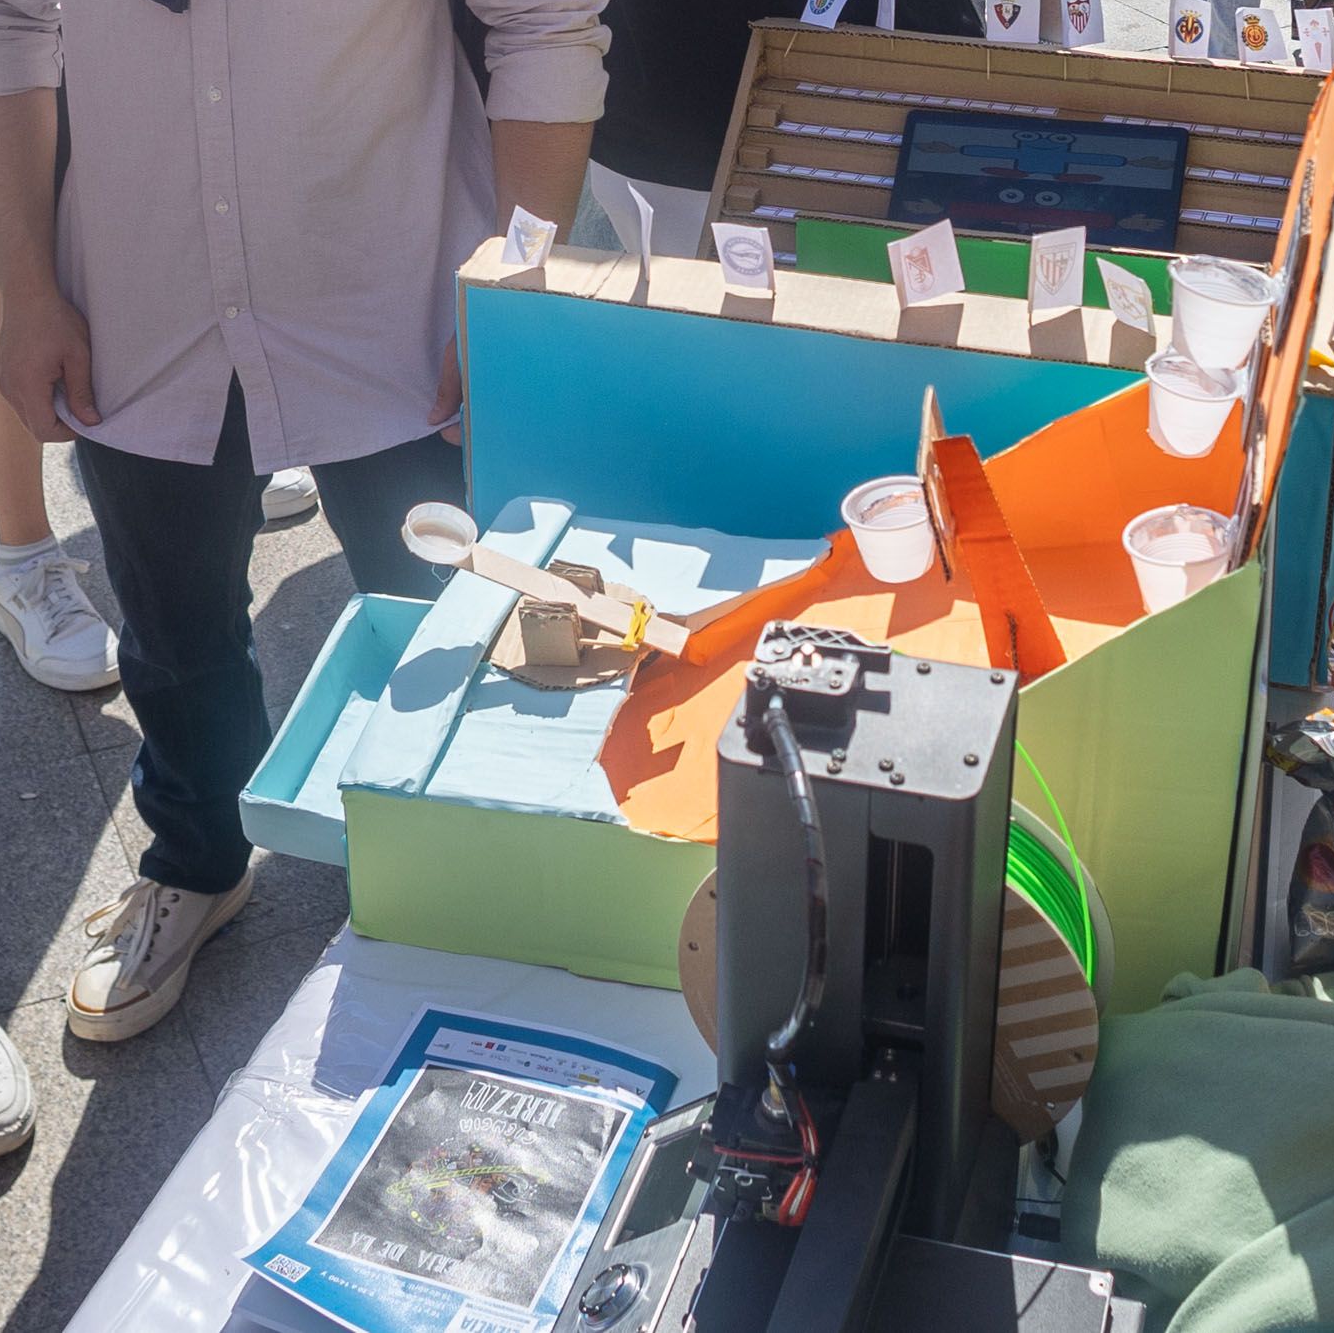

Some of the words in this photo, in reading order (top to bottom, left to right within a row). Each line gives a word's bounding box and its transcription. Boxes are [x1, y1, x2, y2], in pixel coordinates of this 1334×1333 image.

[460, 1080, 500, 1113] 2024
[487, 1088, 567, 1129] JEREZ
[349, 1231, 376, 1254] LA
[377, 1239, 408, 1263] DE
